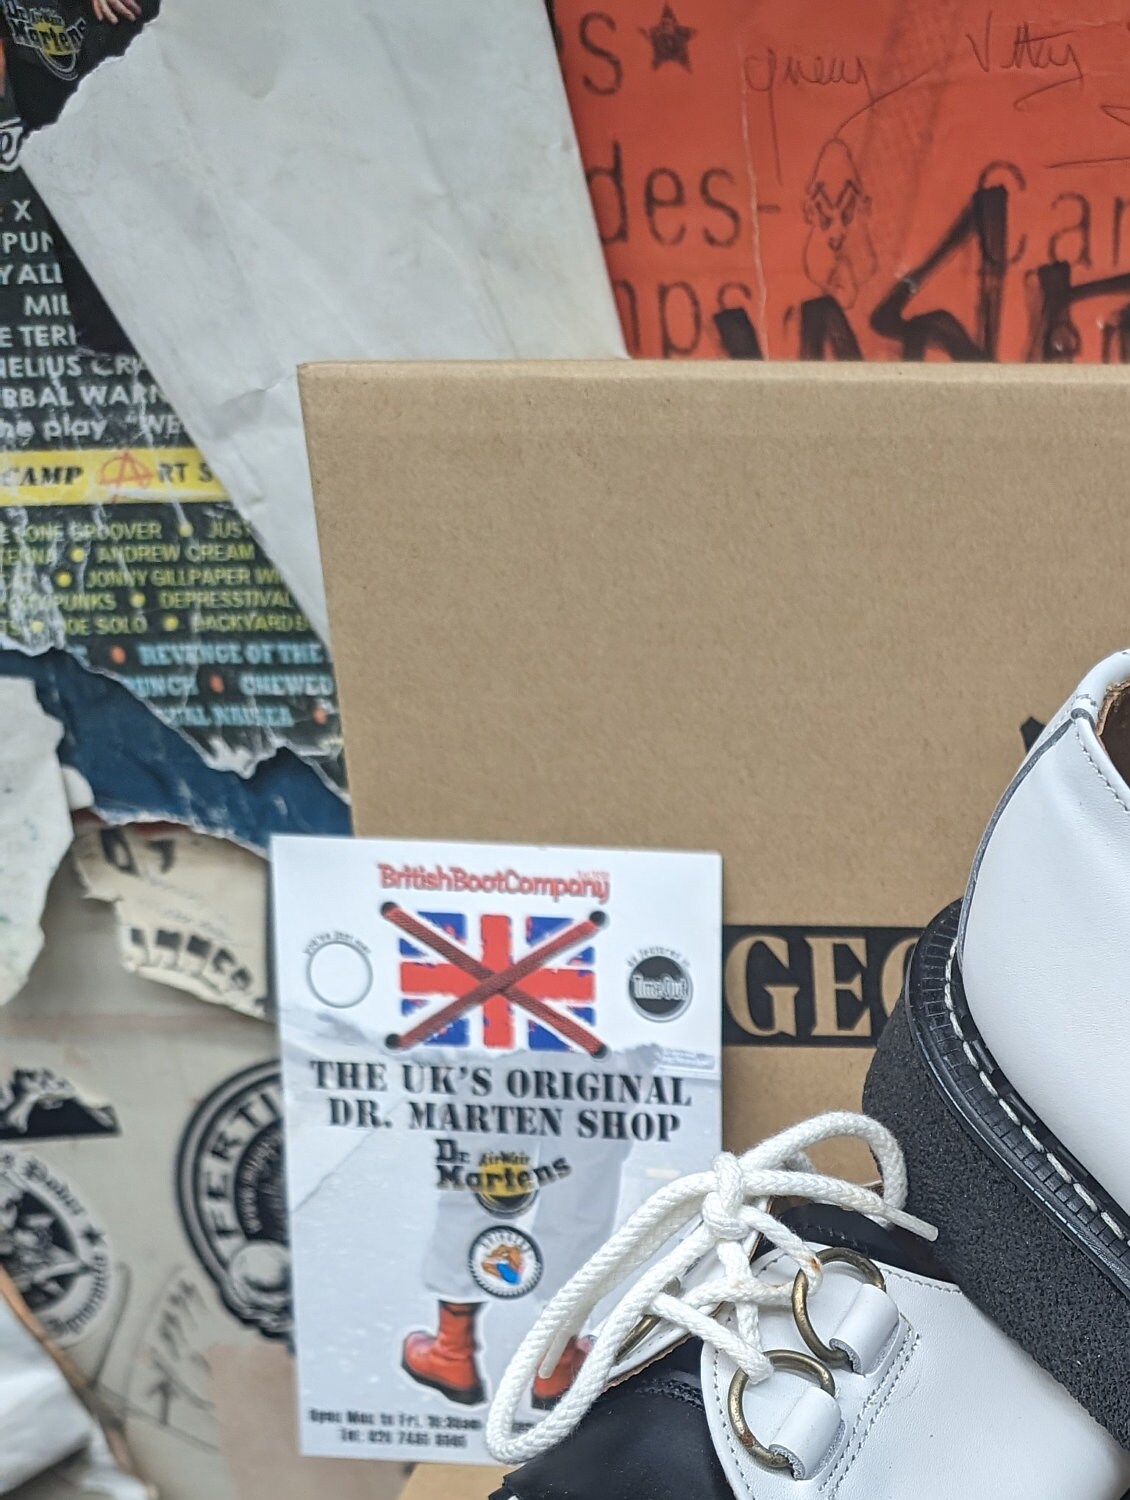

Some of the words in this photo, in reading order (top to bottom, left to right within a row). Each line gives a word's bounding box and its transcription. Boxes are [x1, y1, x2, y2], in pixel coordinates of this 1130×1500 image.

[310, 1060, 387, 1092] THE
[506, 1068, 693, 1108] ORIGINAL
[329, 1097, 393, 1130] DR.
[408, 1101, 564, 1137] MARTEN
[577, 1109, 681, 1144] SHOP
[436, 1156, 573, 1192] Martens
